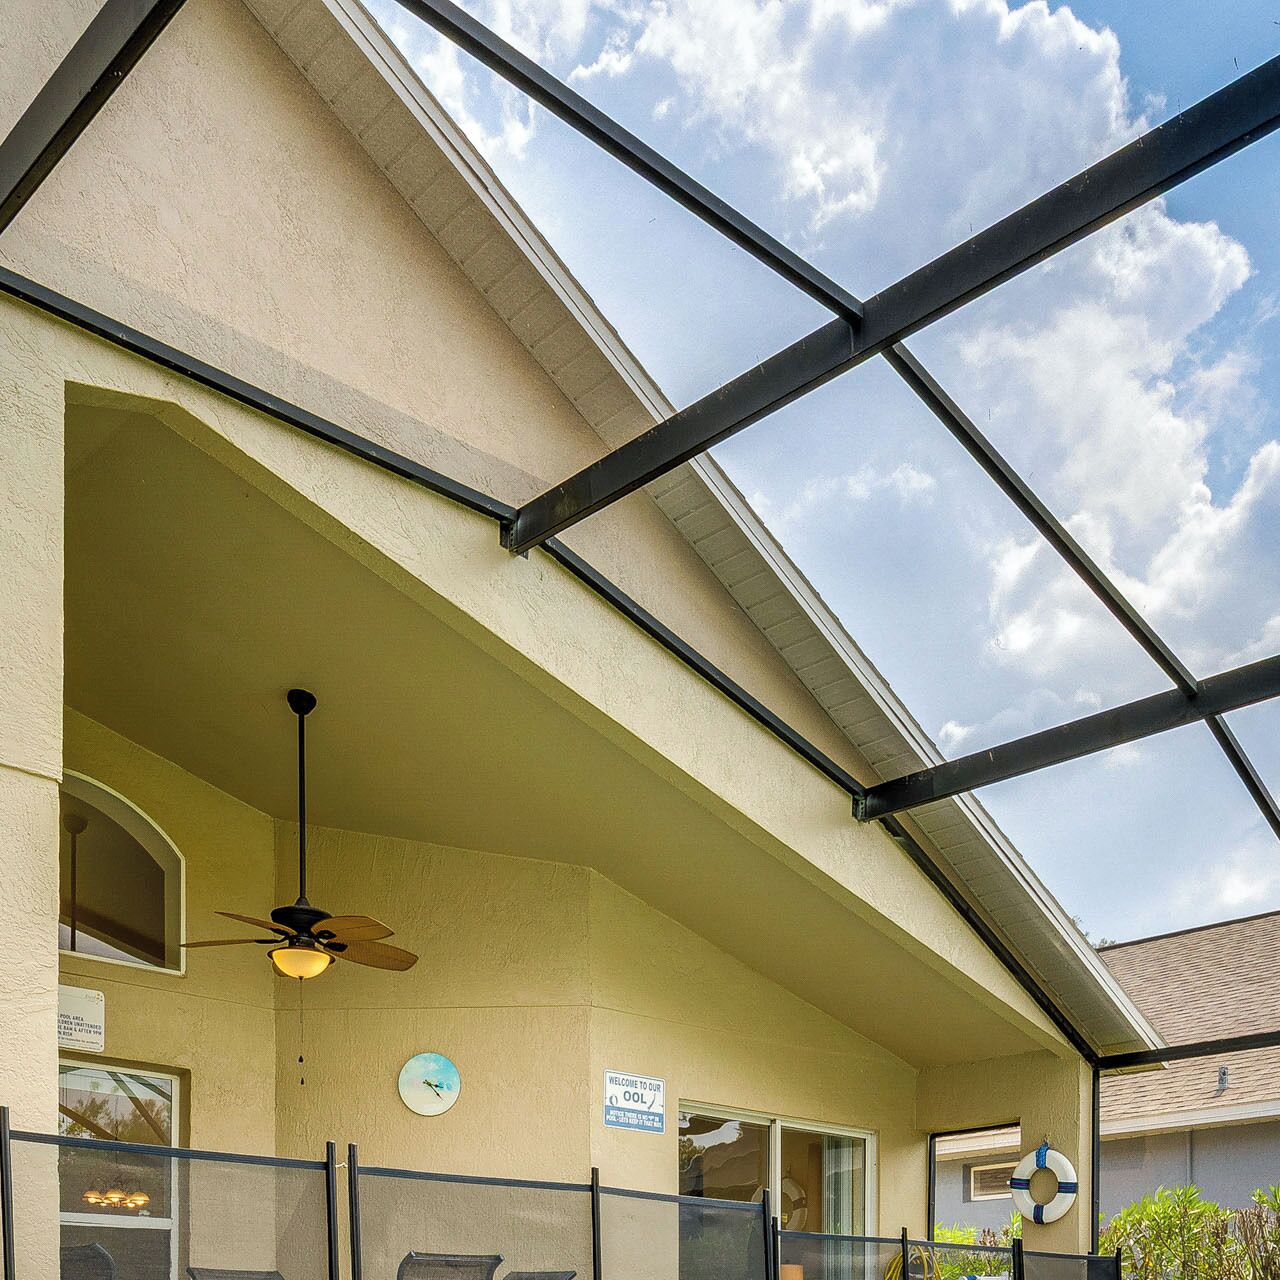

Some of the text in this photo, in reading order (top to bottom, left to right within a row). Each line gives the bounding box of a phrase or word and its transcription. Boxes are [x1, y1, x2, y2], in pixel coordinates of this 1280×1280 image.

[74, 1022, 102, 1030] UNATTENDED
[609, 1076, 661, 1092] WELCOME TO OUR
[623, 1091, 647, 1104] OOL
